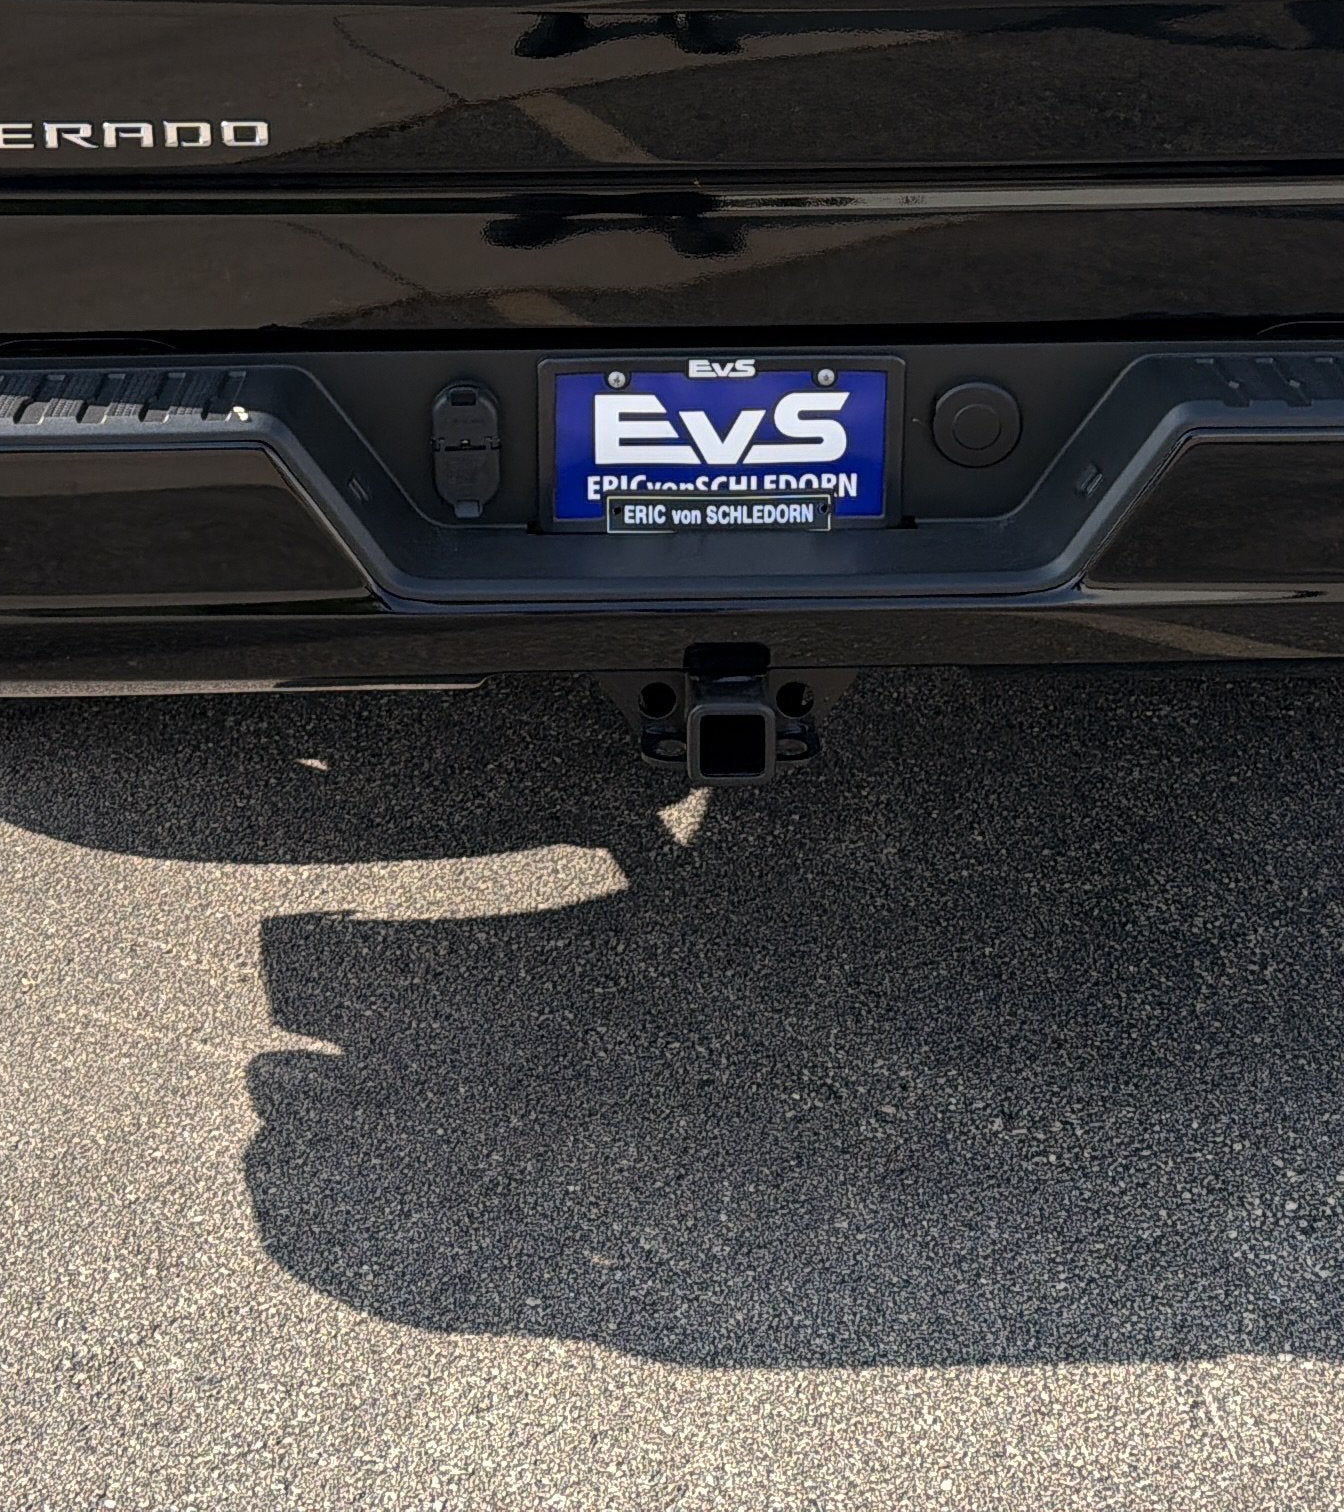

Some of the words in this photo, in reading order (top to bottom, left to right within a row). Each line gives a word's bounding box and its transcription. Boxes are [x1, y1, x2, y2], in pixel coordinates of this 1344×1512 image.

[624, 504, 666, 524] ERIC
[671, 508, 702, 525] von
[706, 504, 814, 524] SCHLEDORN
